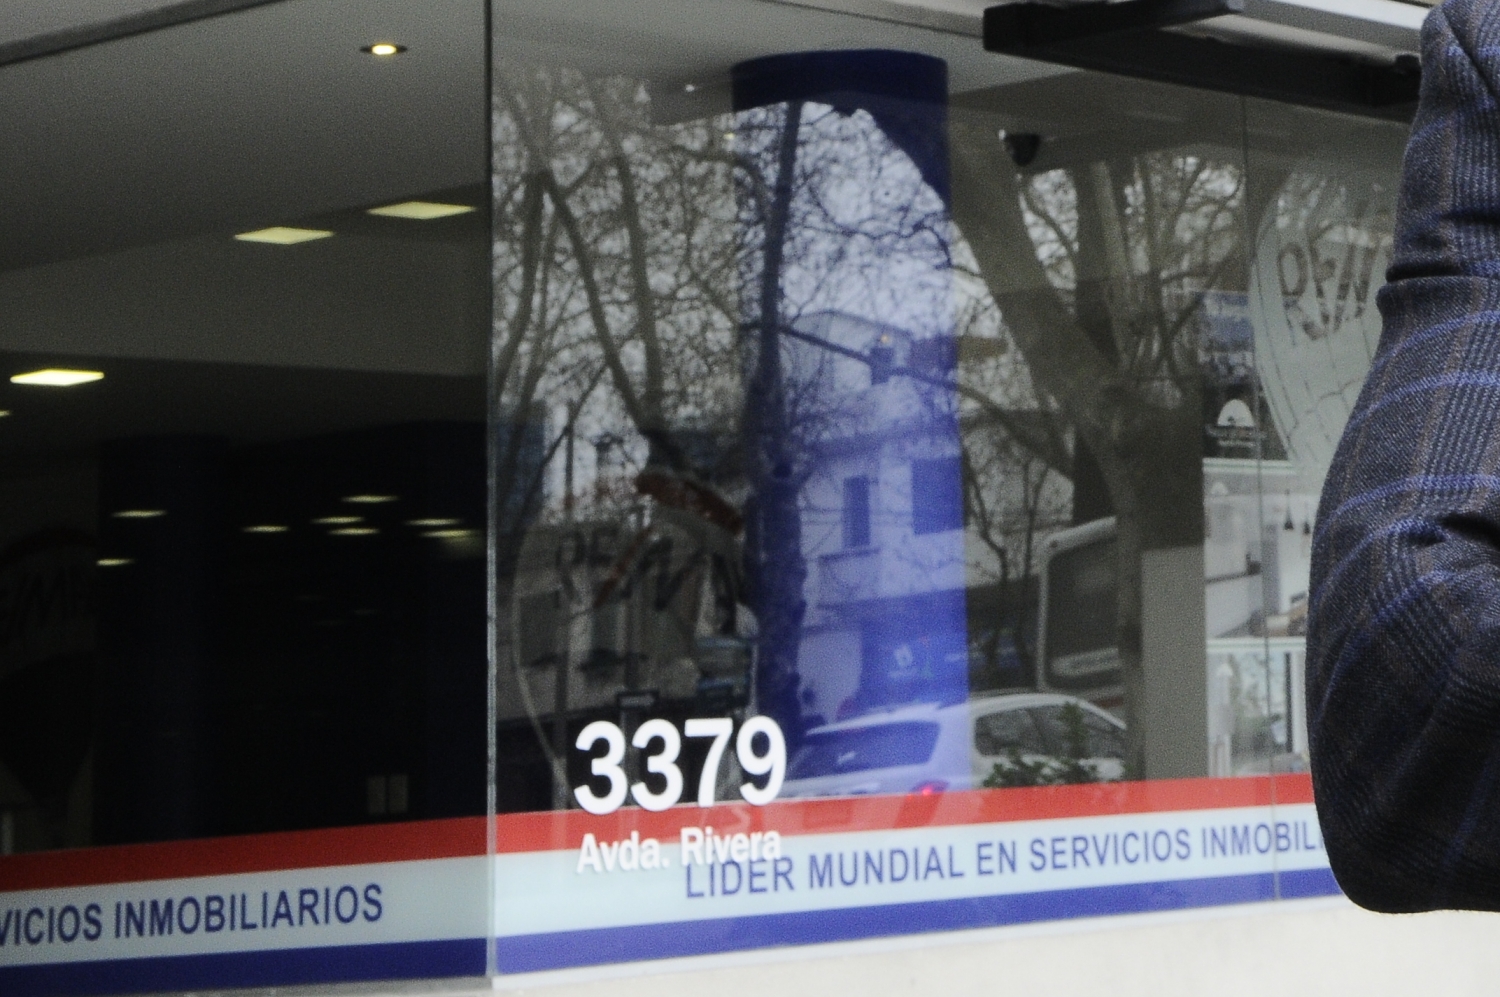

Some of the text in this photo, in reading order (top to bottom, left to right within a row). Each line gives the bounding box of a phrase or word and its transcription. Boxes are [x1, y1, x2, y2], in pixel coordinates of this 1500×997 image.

[573, 716, 787, 815] 3379
[576, 826, 782, 874] Avda. Rivera
[808, 845, 965, 890] MUNDIAL
[976, 839, 1018, 876] EN
[1029, 828, 1191, 873] SERVICIOS
[1202, 821, 1325, 858] INMOBIL
[114, 883, 383, 939] INMOBILIARIOS
